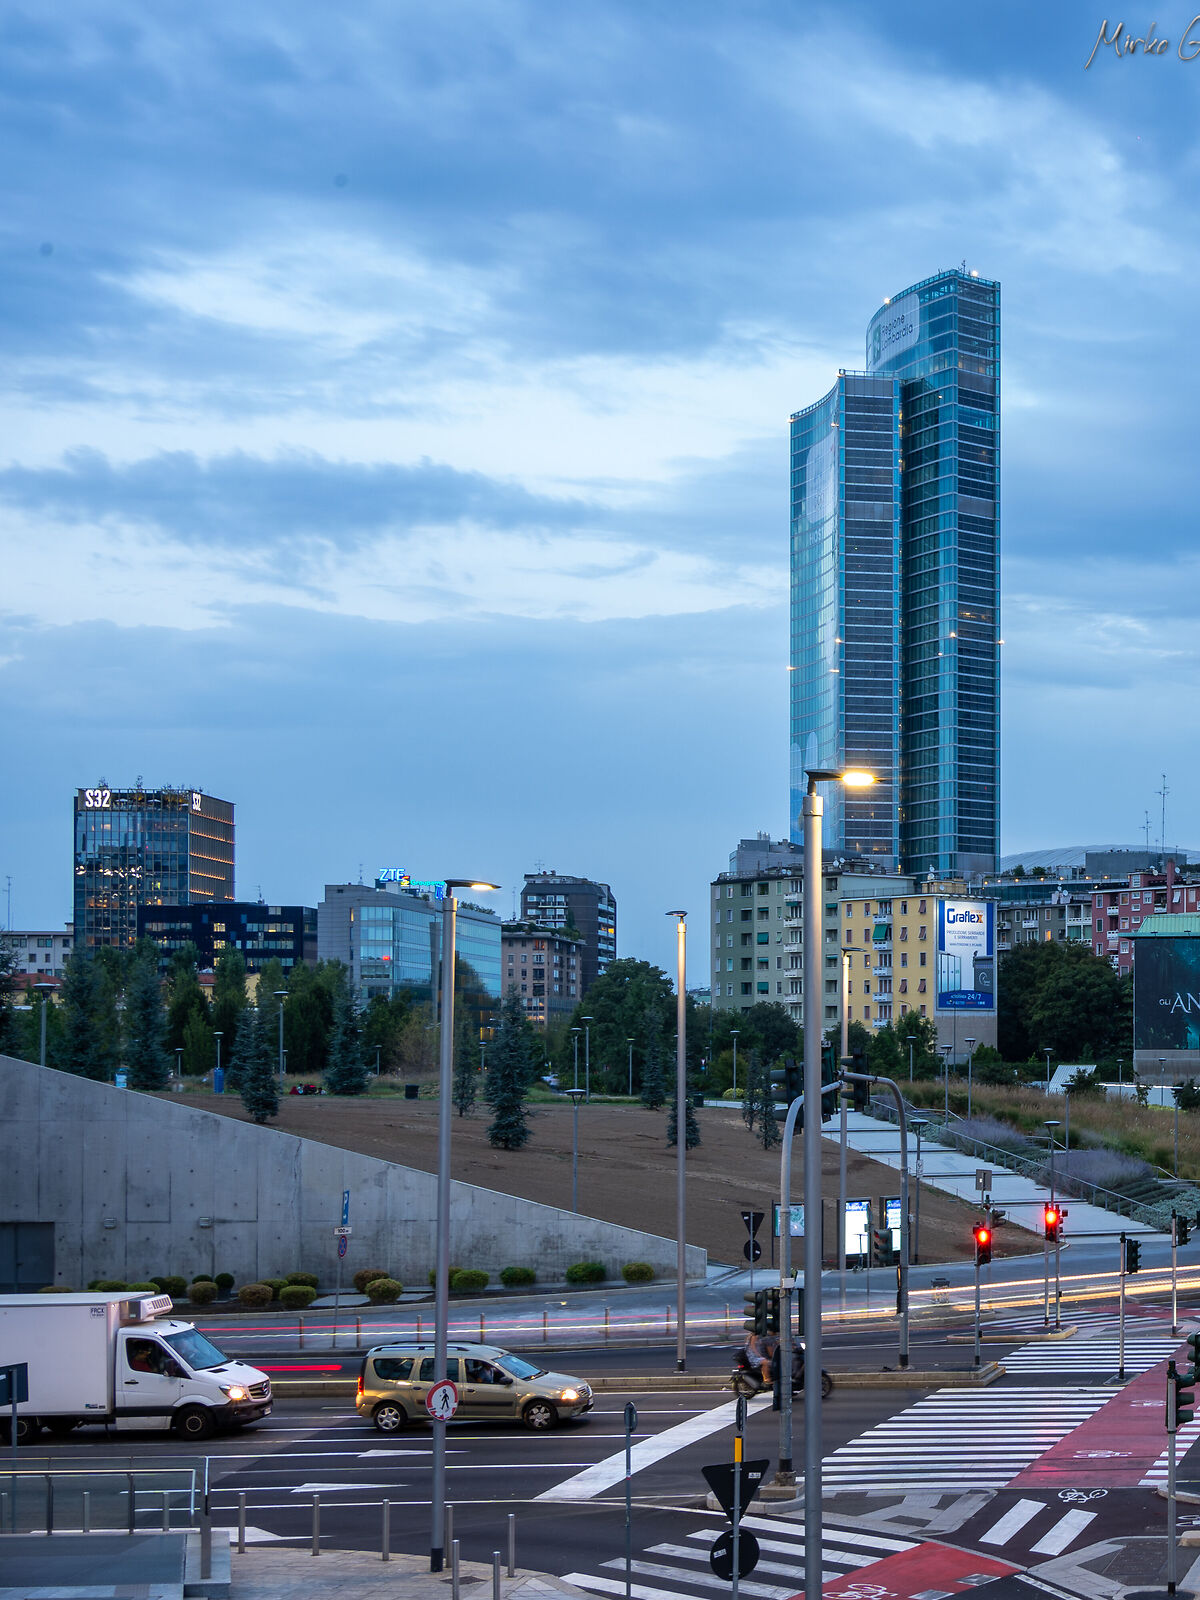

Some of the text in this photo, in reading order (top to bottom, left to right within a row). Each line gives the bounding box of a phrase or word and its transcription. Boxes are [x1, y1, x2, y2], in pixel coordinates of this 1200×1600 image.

[881, 314, 905, 335] Regione
[881, 323, 913, 351] Lombardia
[85, 790, 111, 808] S32
[192, 793, 202, 811] S32
[379, 868, 405, 881] ZTE
[946, 908, 984, 924] Graflex
